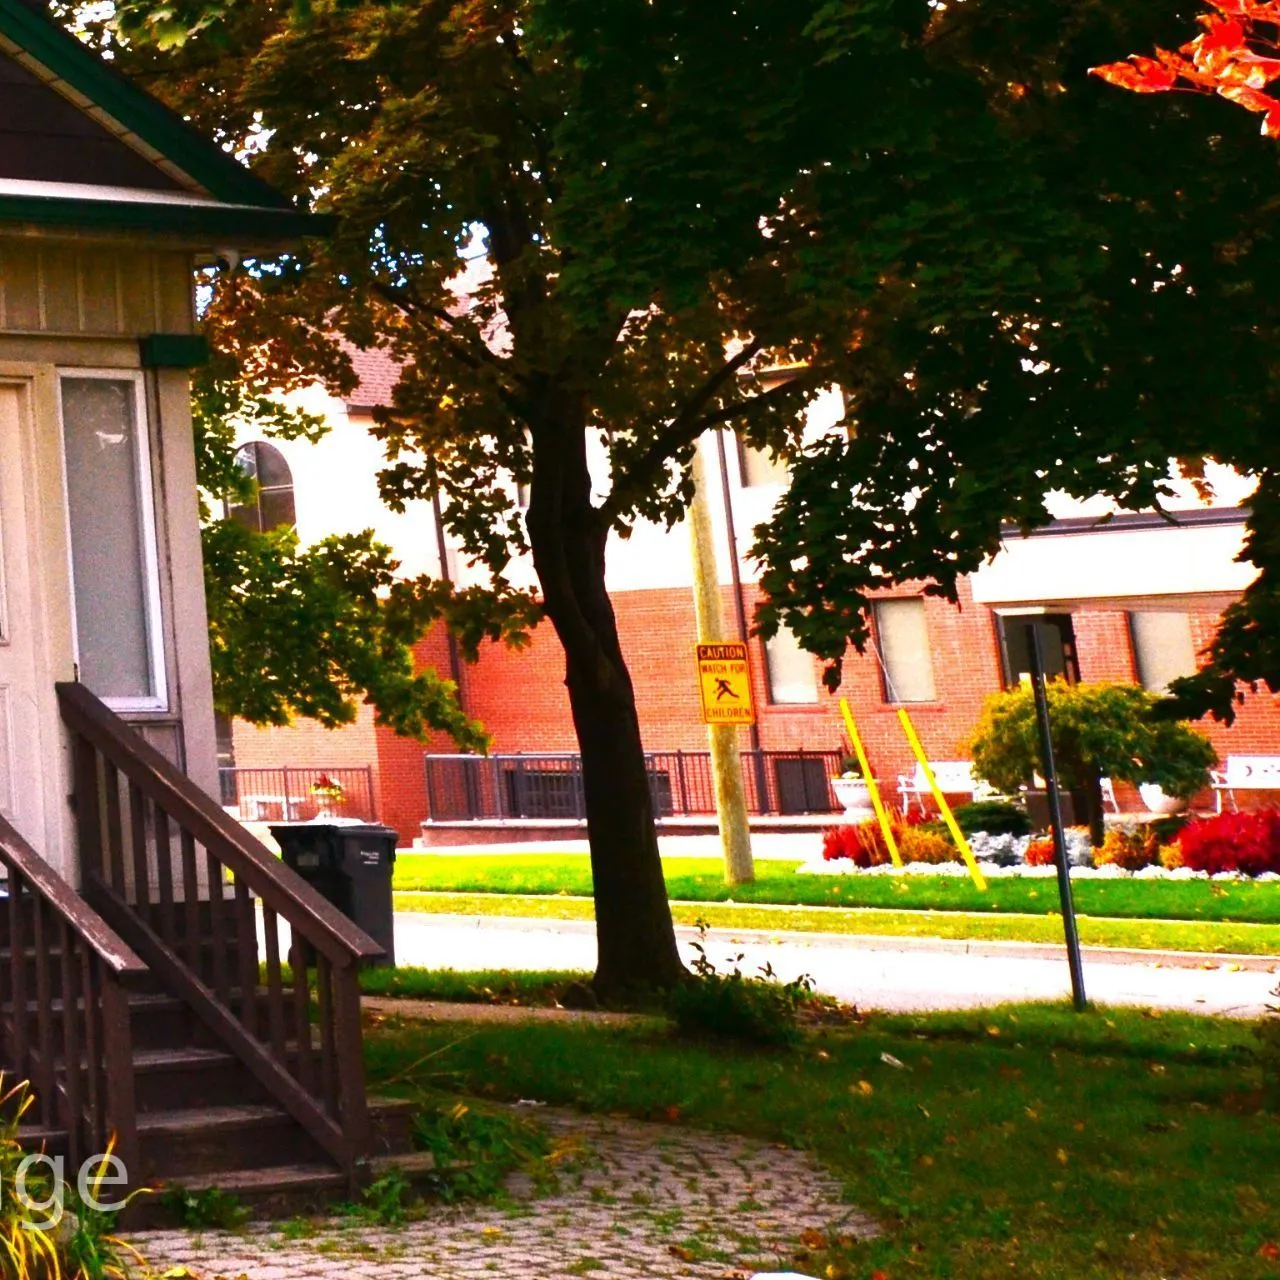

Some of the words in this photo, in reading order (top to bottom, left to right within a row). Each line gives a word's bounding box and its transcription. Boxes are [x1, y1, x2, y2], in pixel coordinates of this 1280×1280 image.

[700, 646, 744, 659] CAUTION
[702, 663, 727, 673] WATCH
[730, 663, 745, 673] FOR
[706, 707, 751, 718] CHILDREN
